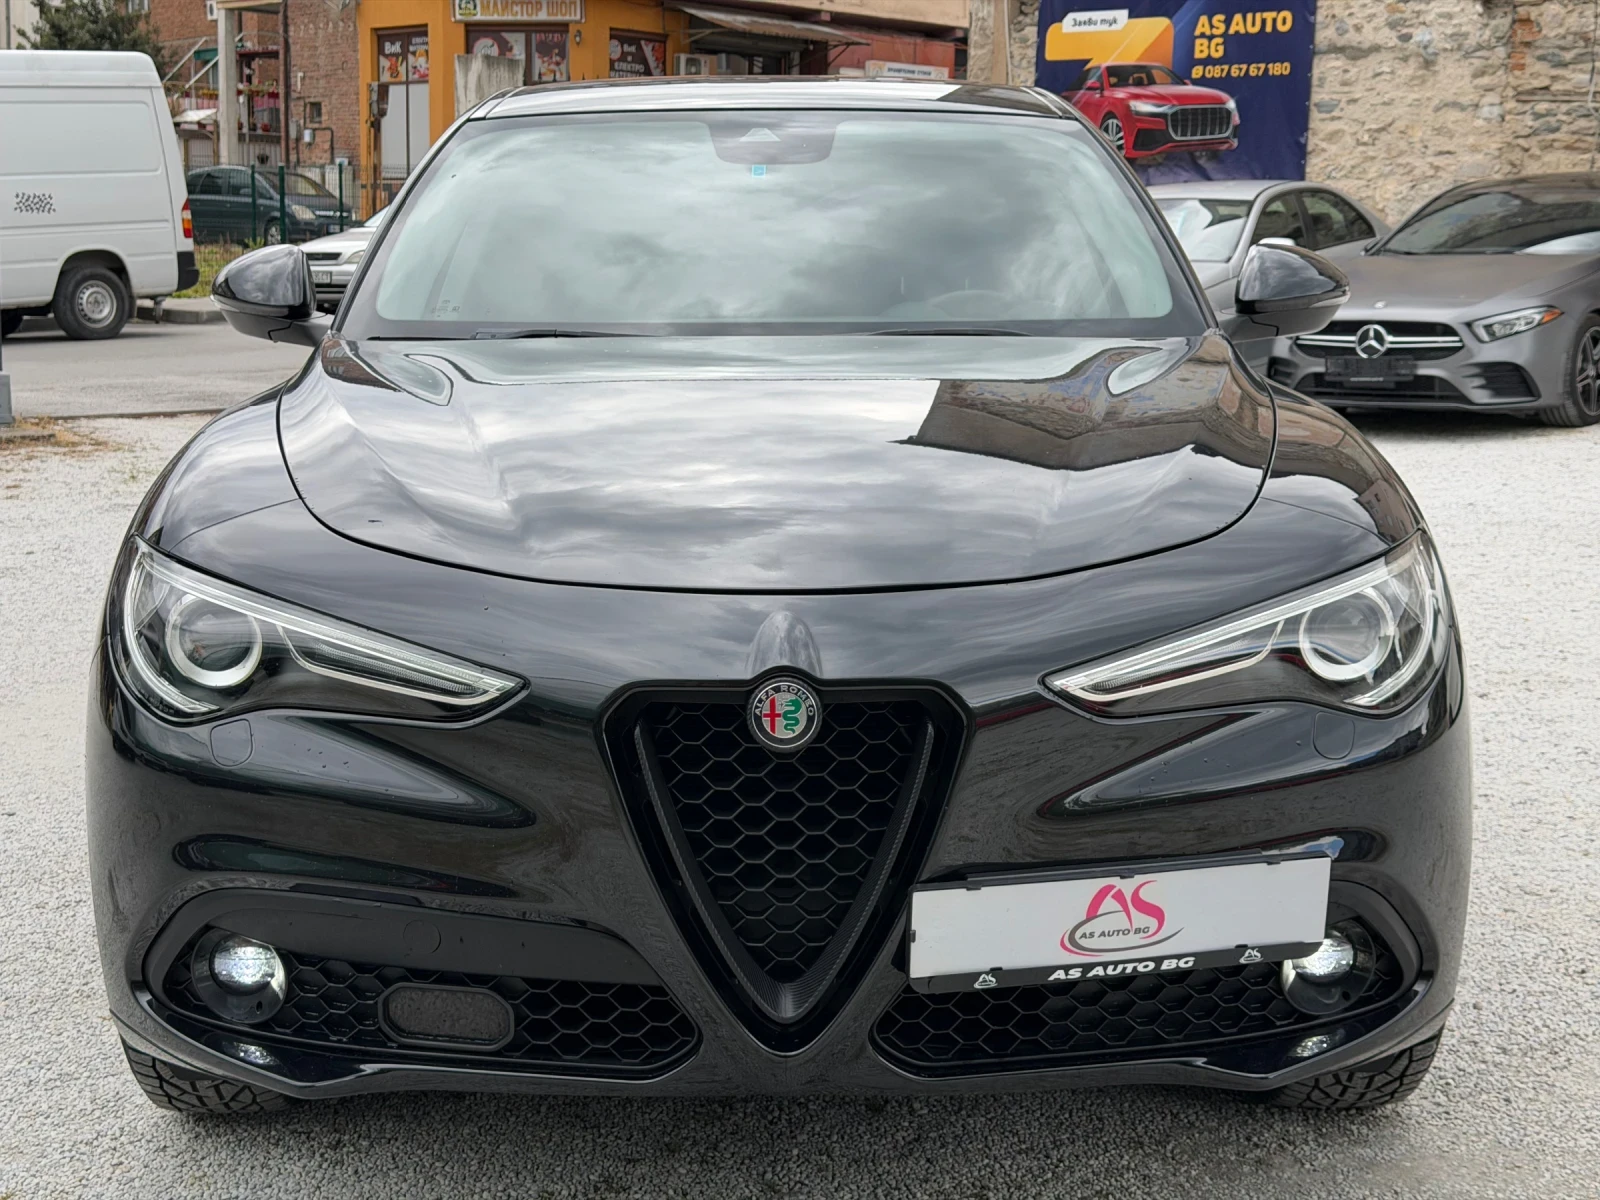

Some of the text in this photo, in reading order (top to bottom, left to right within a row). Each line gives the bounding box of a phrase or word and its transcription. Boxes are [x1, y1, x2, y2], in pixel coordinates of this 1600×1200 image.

[547, 0, 577, 17] ШОП
[1194, 10, 1293, 36] AS AUTO
[1194, 37, 1224, 59] BG
[1205, 61, 1291, 78] 087 67 67 180
[755, 684, 814, 716] ALFA ROMEO
[1085, 880, 1165, 940] AS
[1079, 926, 1150, 940] AS AUTO BG
[1048, 957, 1195, 981] AS AUTO BG
